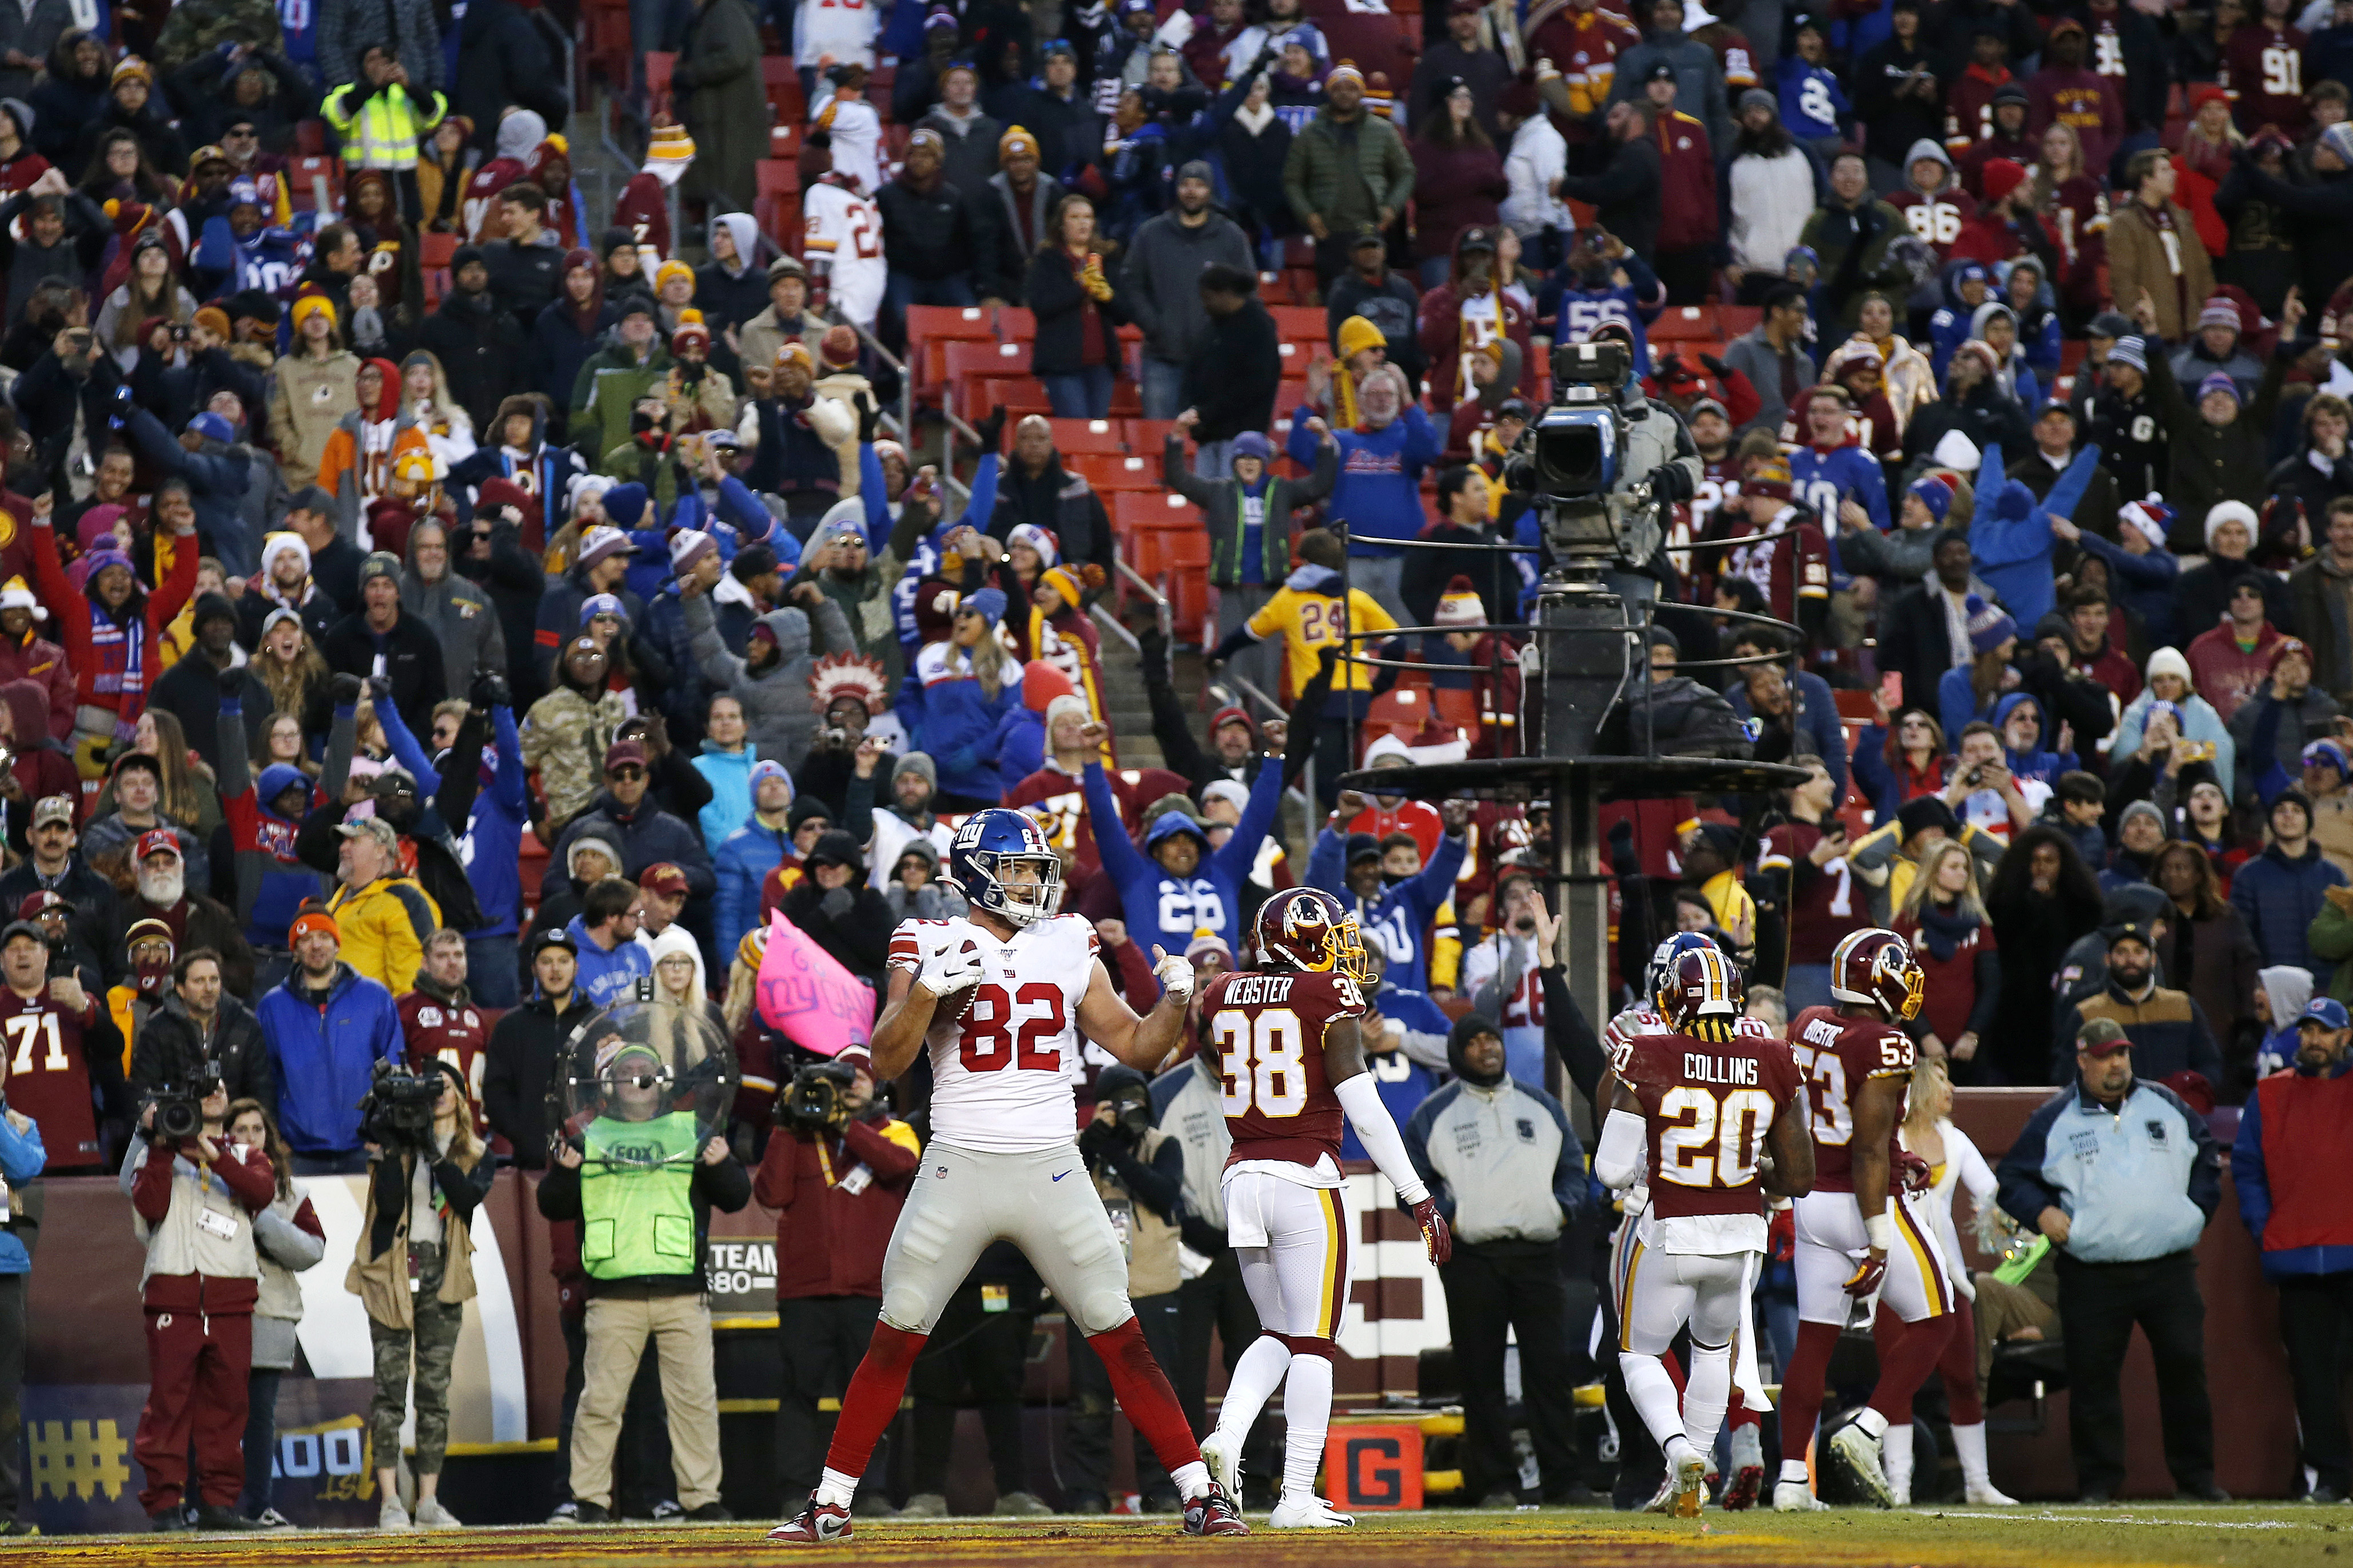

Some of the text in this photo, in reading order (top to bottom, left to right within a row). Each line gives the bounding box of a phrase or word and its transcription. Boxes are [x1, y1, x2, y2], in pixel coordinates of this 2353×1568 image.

[2262, 47, 2303, 95] 91
[1905, 203, 1962, 244] 86
[1300, 601, 1345, 643] 24
[1224, 976, 1293, 1004] WEBSTER
[1332, 977, 1366, 1007] 38
[5, 1012, 69, 1076] 71
[957, 983, 1066, 1072] 82
[1803, 1018, 1844, 1048] BOSTIC
[1211, 1008, 1308, 1118] 38
[1684, 1052, 1758, 1085] COLLINS
[1879, 1036, 1915, 1066] 53
[1659, 1086, 1776, 1187] 20
[710, 1244, 778, 1276] TEAM
[1346, 1438, 1400, 1506] G
